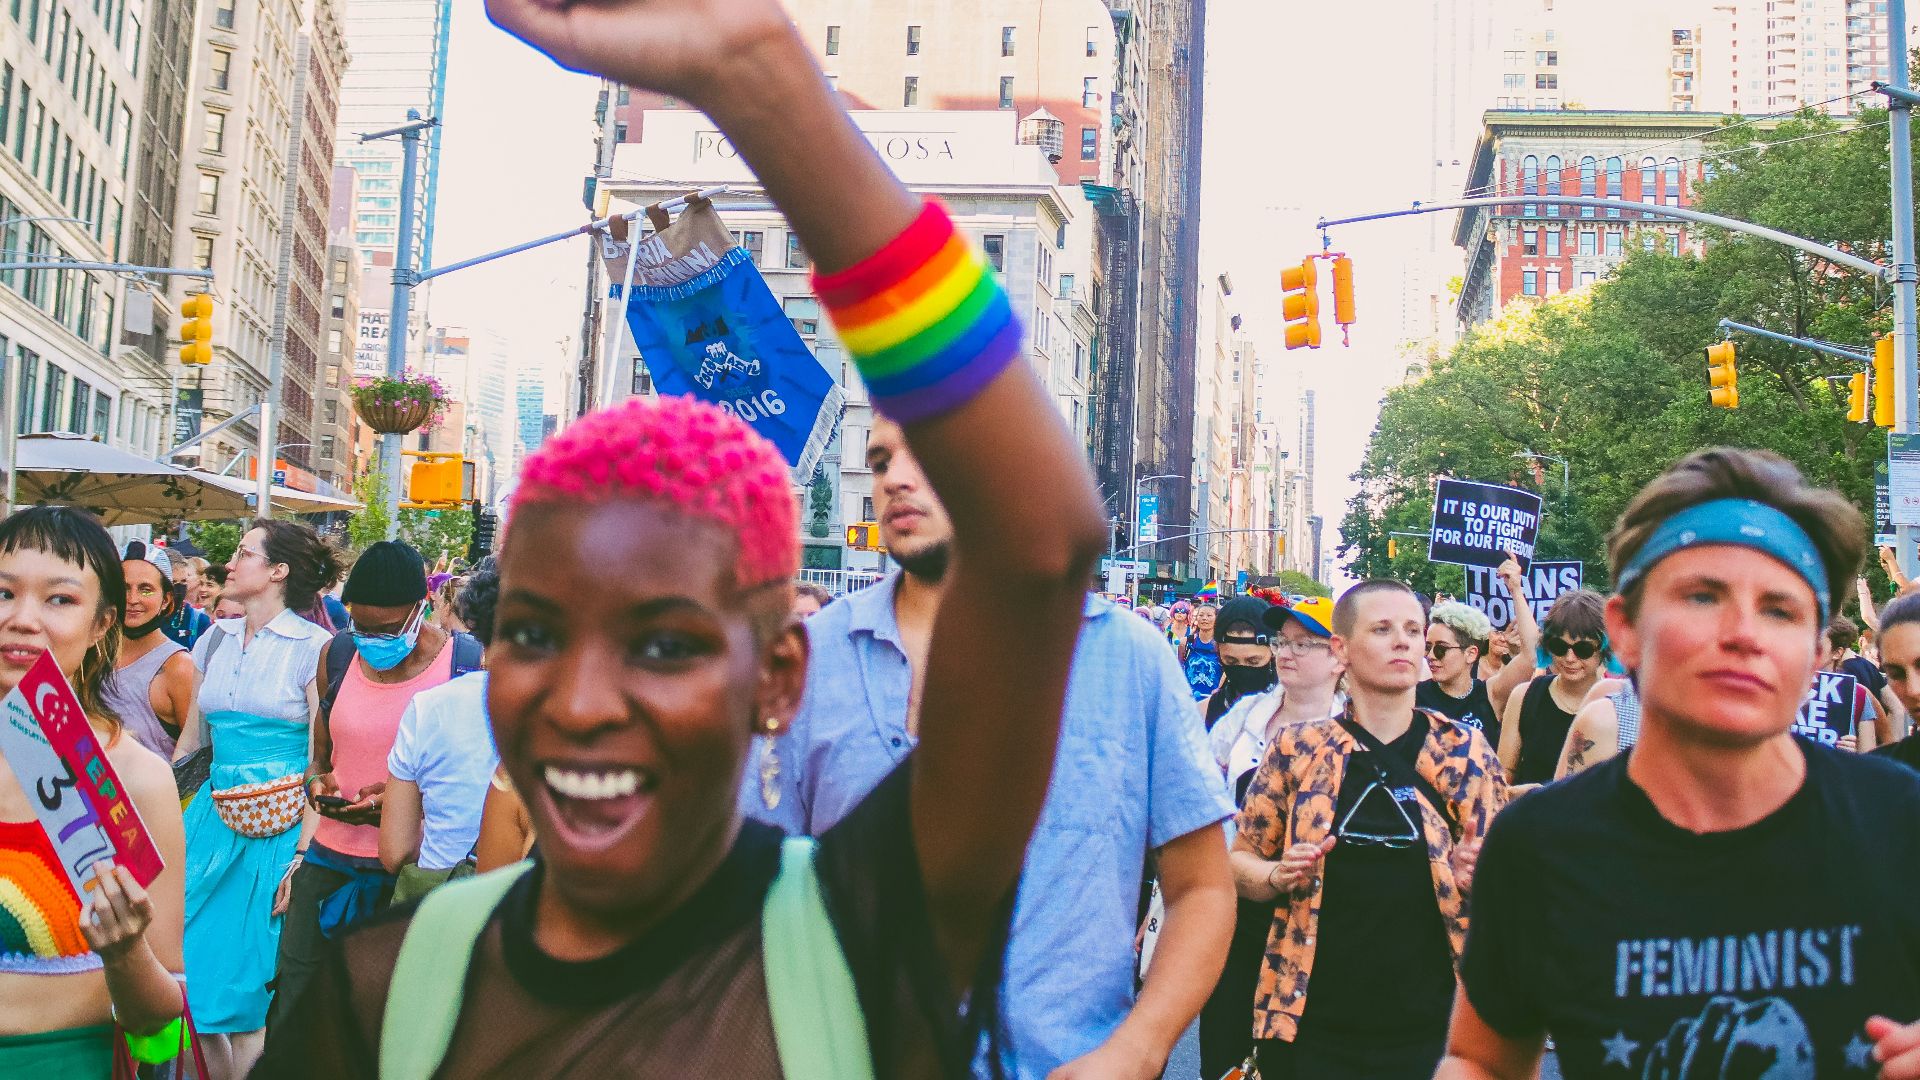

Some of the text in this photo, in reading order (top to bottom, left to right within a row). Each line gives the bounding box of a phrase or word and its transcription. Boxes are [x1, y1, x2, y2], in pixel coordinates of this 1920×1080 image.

[361, 326, 419, 340] REAY
[1443, 499, 1536, 530] IT IS OUR DUTY
[1435, 528, 1461, 545] FOR
[1464, 533, 1492, 550] OUR
[1464, 516, 1525, 540] TO FIGHT
[1615, 923, 1862, 998] FEMINIST
